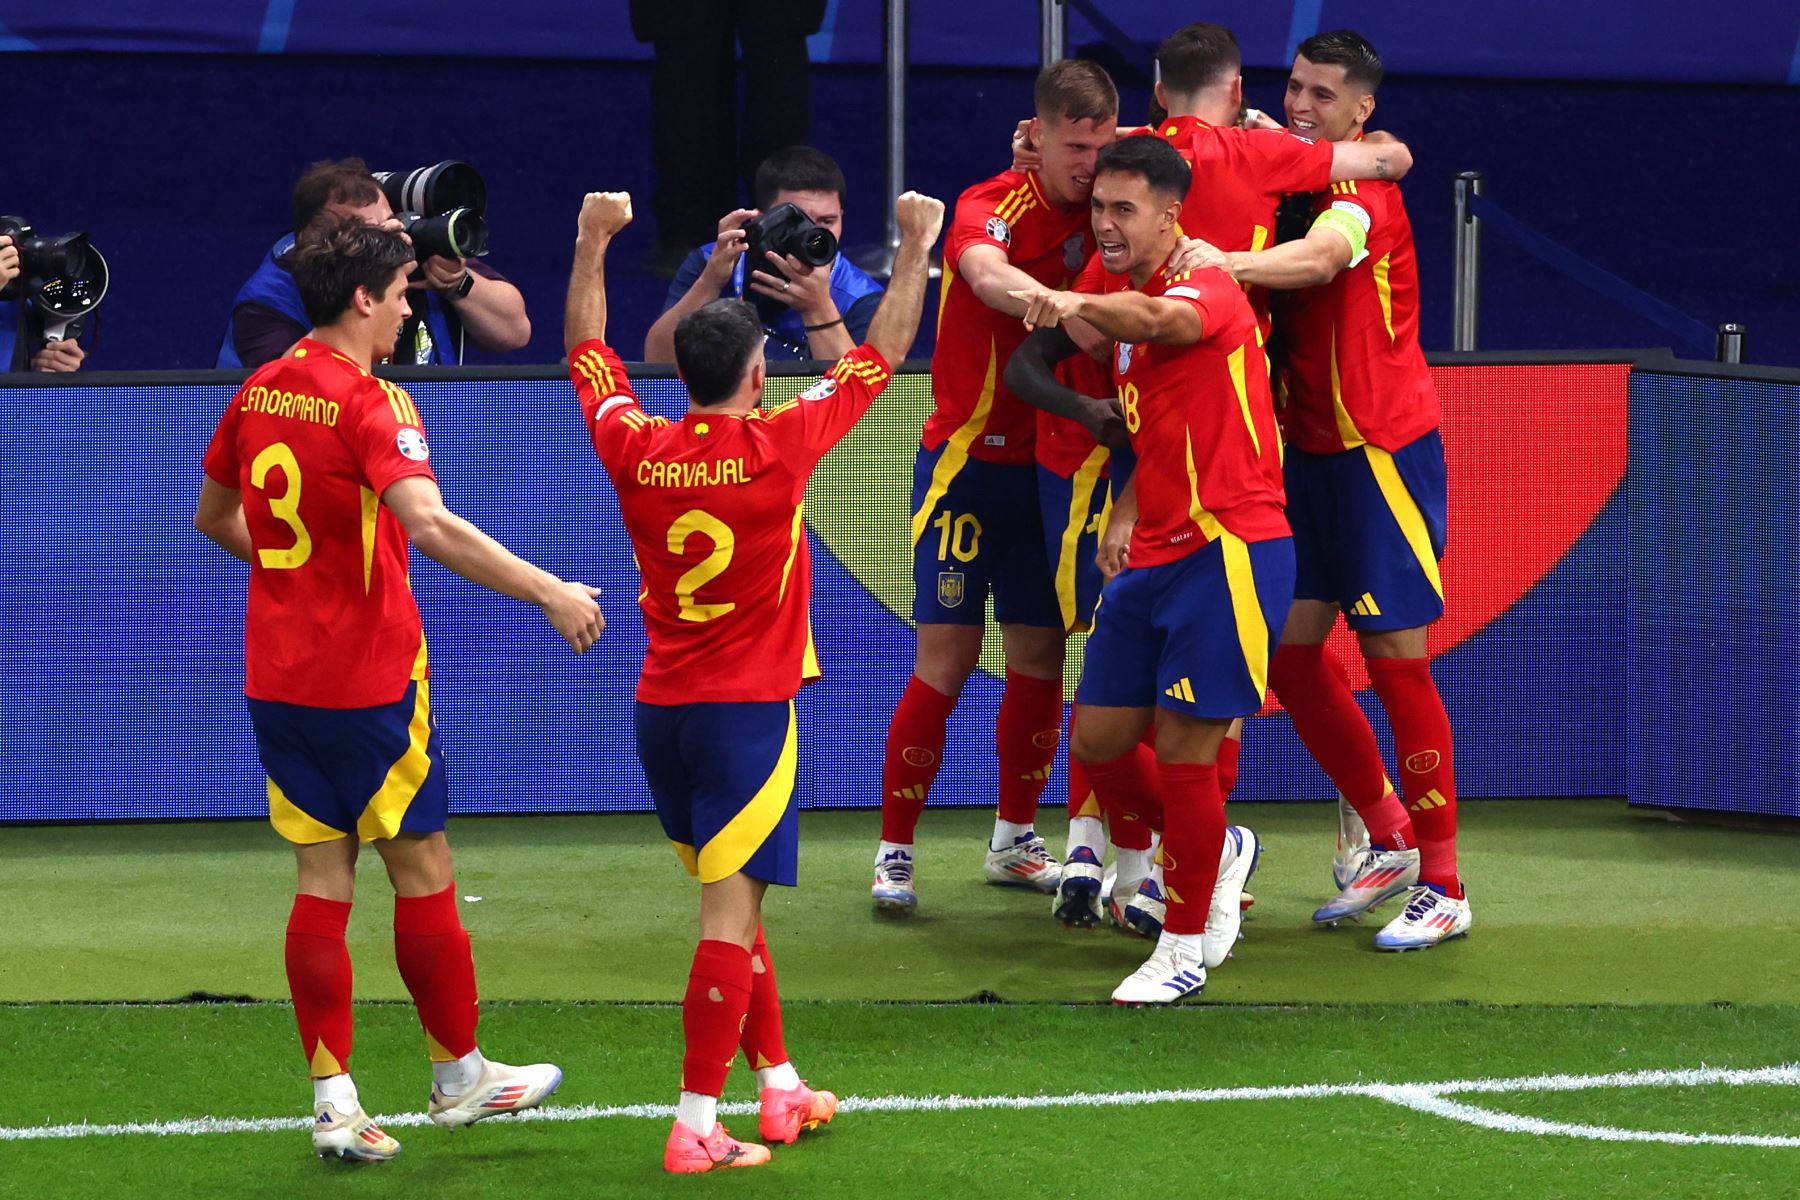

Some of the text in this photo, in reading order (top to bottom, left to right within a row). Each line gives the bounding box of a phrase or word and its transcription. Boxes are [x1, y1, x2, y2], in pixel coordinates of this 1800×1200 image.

[250, 441, 312, 569] 3
[636, 457, 752, 488] CARVAJAL
[666, 508, 736, 623] 2
[933, 510, 983, 563] 10
